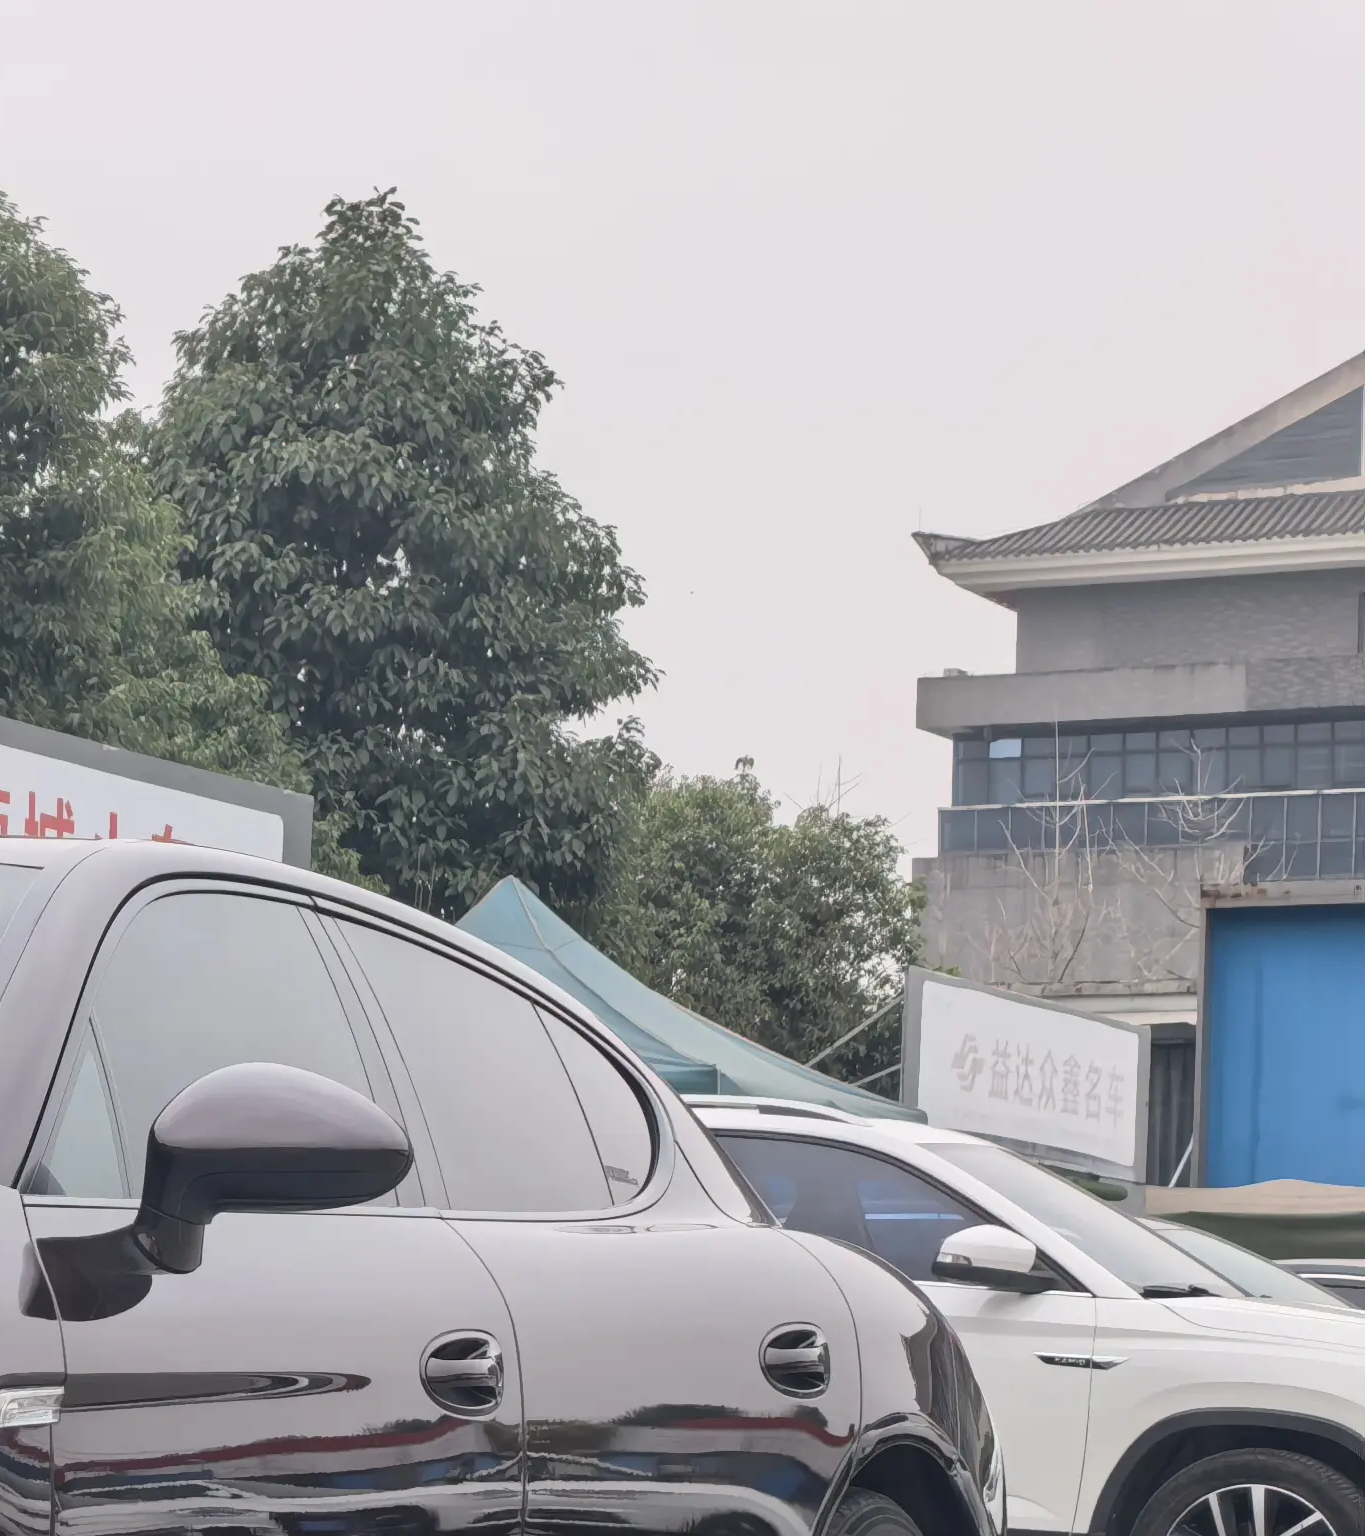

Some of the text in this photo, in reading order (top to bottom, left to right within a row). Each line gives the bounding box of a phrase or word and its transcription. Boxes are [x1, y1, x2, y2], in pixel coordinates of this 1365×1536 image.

[988, 1038, 1125, 1129] 益达众鑫名车
